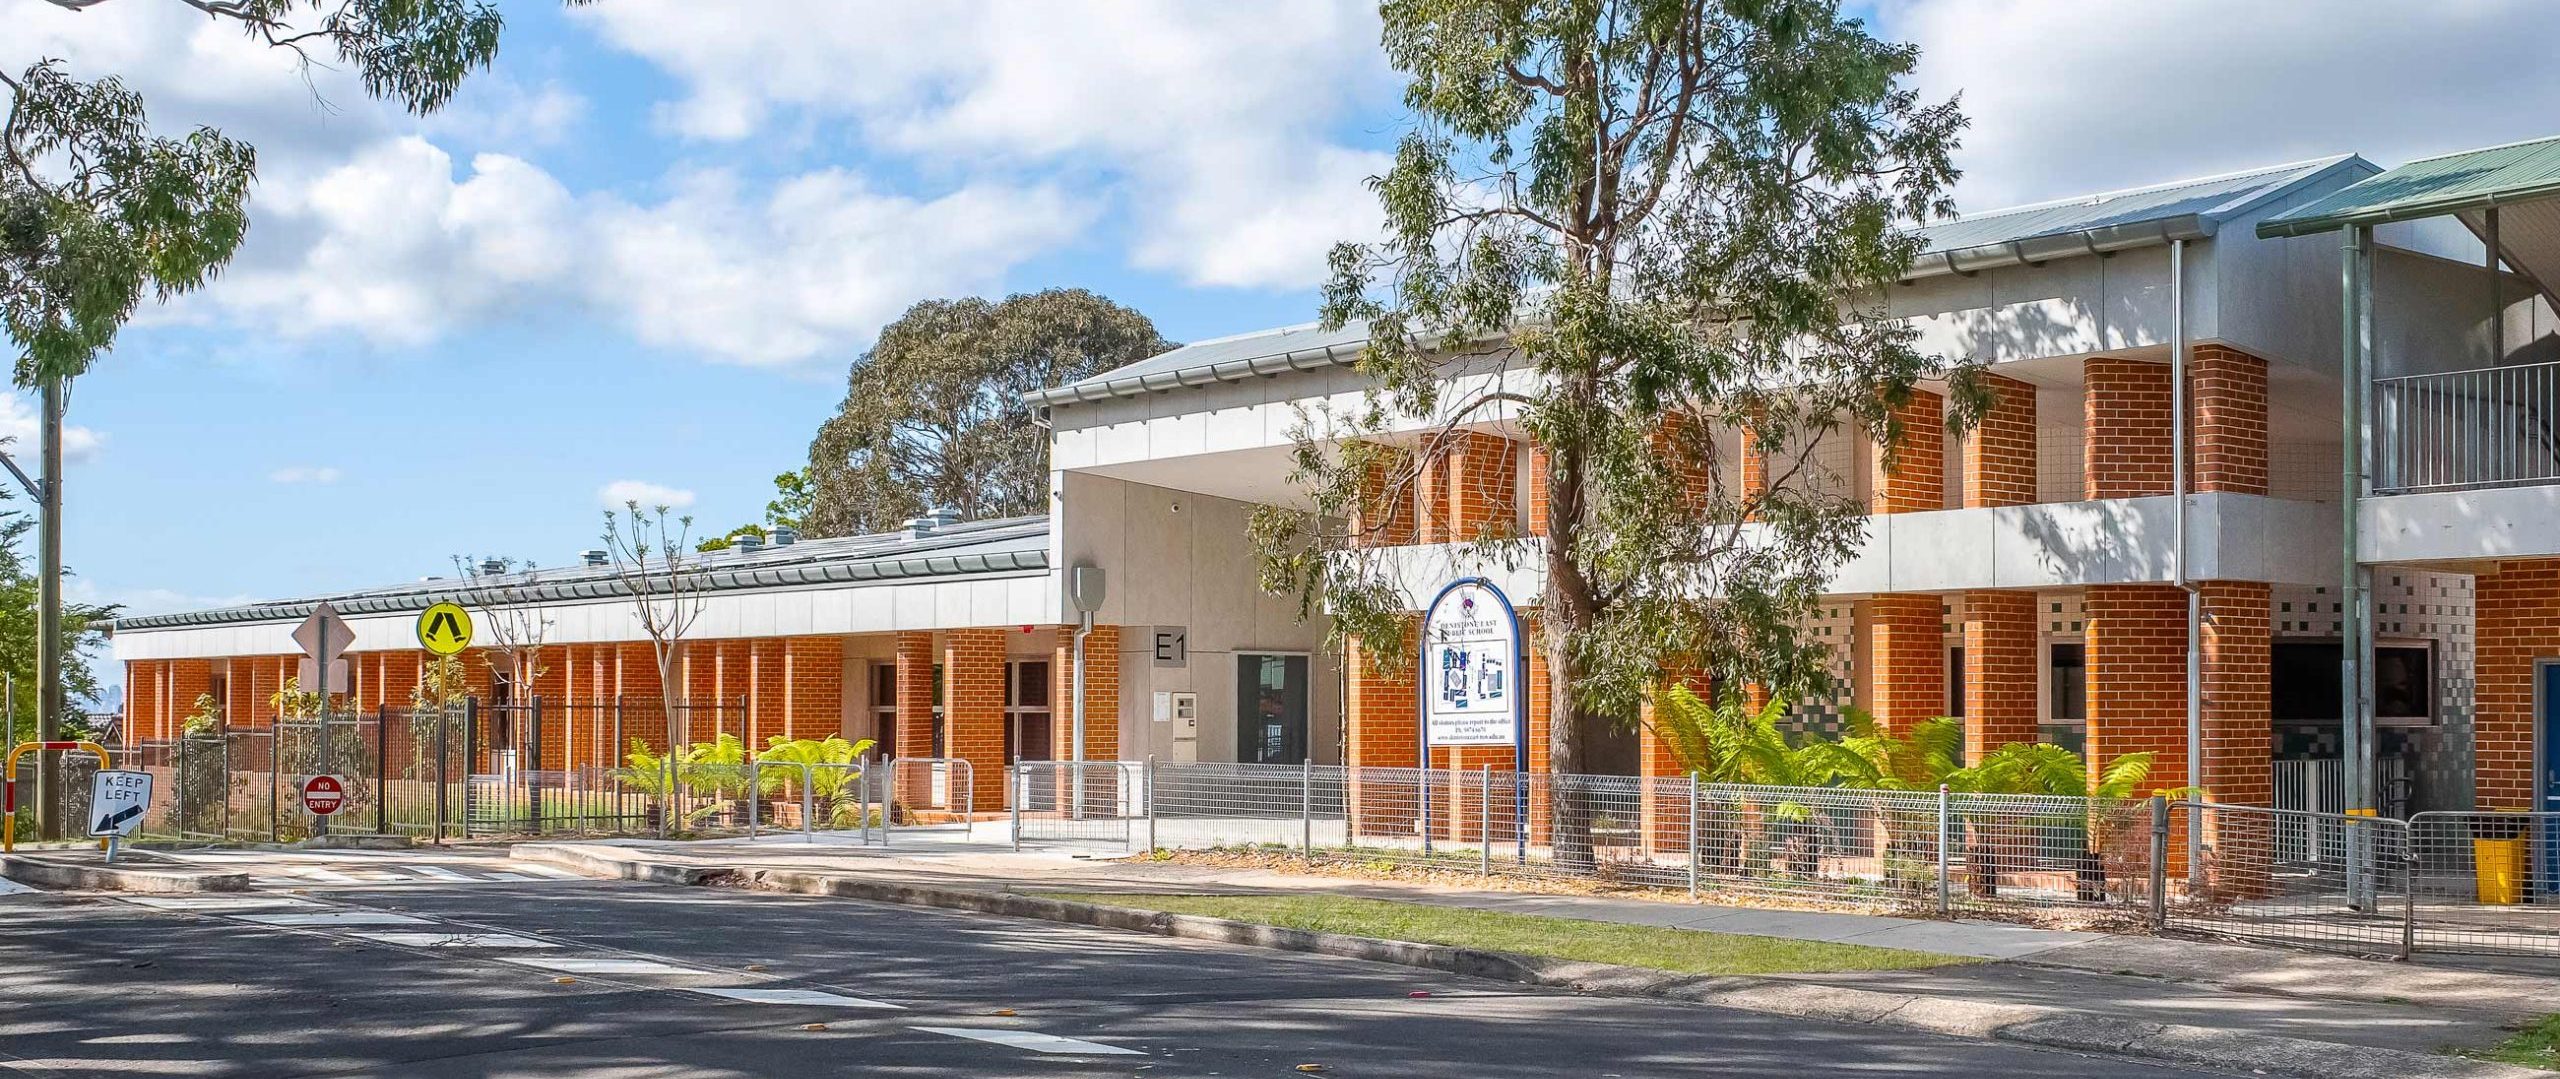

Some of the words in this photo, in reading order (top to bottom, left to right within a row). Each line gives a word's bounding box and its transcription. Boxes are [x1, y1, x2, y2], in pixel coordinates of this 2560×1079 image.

[1156, 633, 1185, 661] E1
[105, 776, 143, 788] KEEP
[317, 782, 331, 791] NO
[105, 789, 141, 802] LEFT
[308, 800, 338, 809] ENTRY
